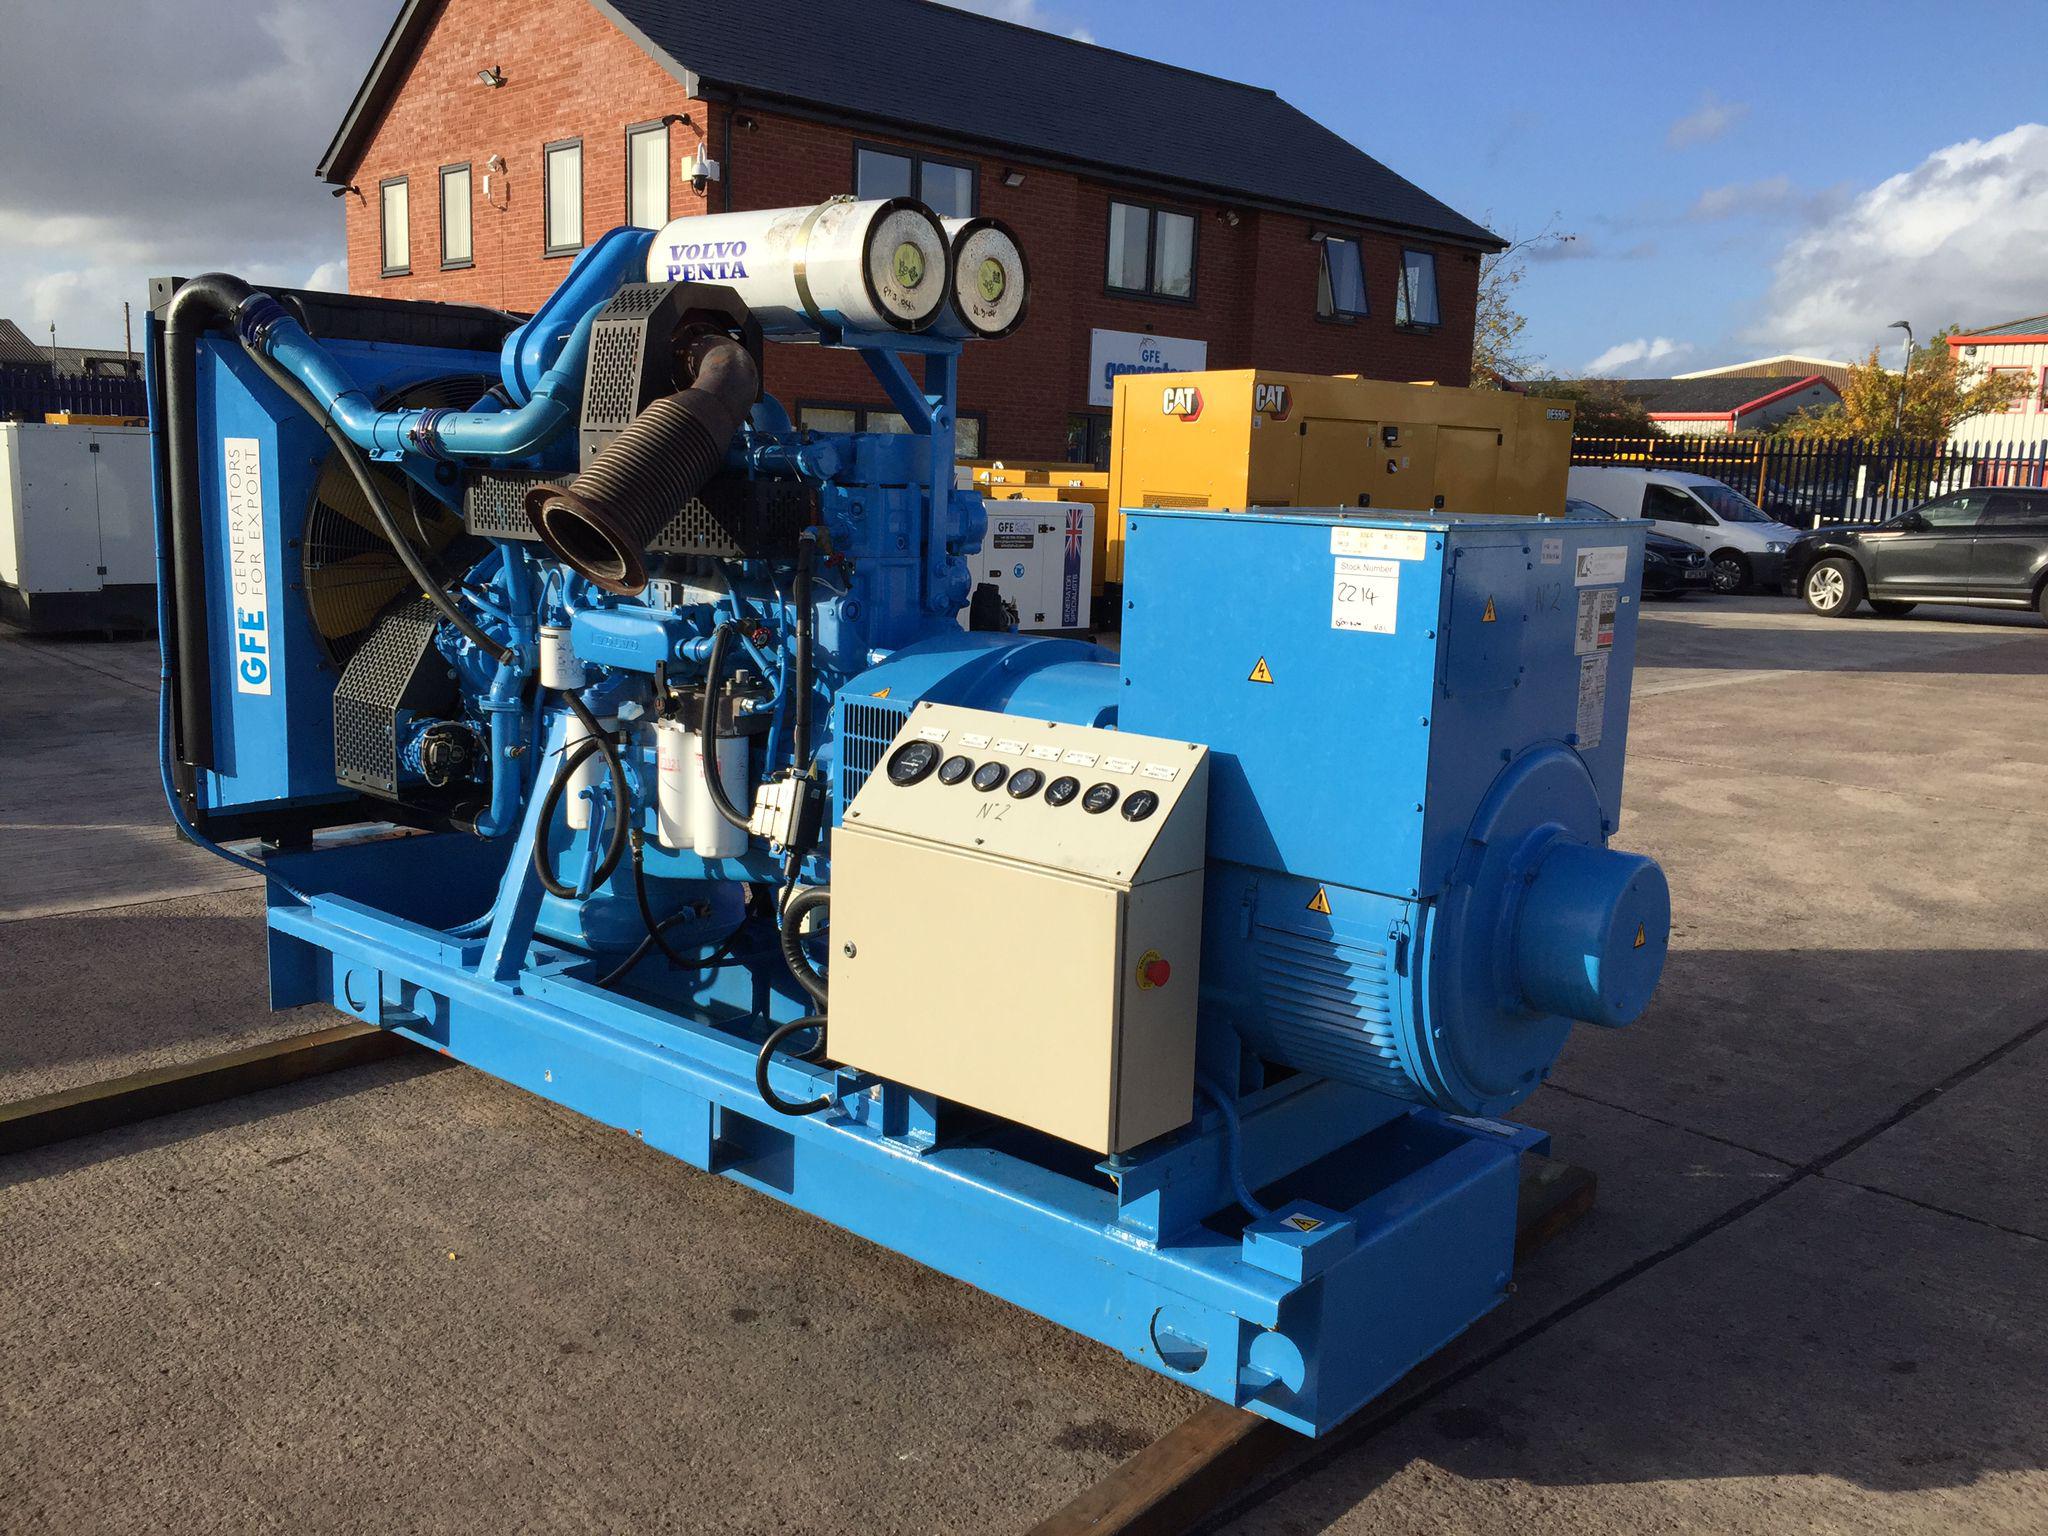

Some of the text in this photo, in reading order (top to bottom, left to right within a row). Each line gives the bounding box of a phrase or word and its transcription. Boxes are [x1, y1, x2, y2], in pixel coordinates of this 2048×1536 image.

[669, 241, 747, 262] VOLVO
[666, 260, 750, 283] PENTA
[1142, 349, 1160, 363] GFE
[1163, 387, 1195, 415] CAT
[1256, 384, 1284, 411] CAT
[228, 449, 248, 595] GENERATORS
[245, 449, 263, 596] FOR EXPORT
[998, 522, 1014, 533] GFE
[1341, 562, 1393, 573] Stock Number
[1338, 582, 1379, 606] 2214
[239, 610, 267, 685] GFE
